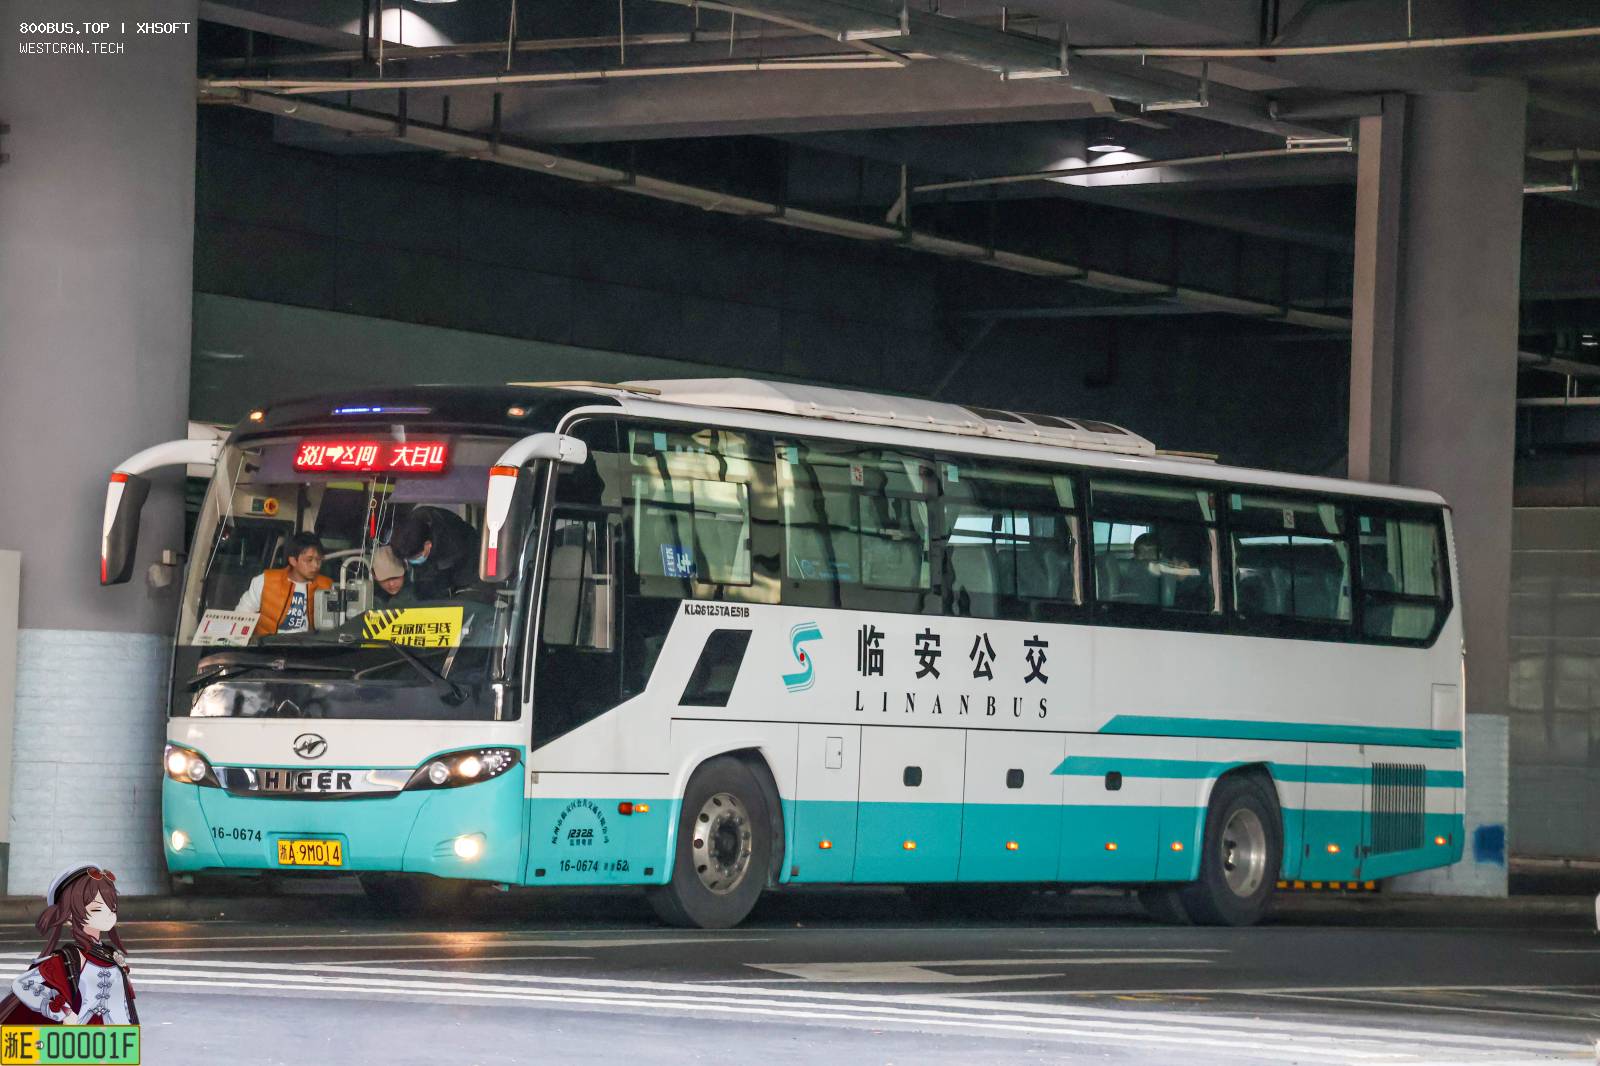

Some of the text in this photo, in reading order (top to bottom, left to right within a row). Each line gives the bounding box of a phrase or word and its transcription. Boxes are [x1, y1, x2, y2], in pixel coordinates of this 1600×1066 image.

[857, 624, 1049, 685] 临安公交
[855, 690, 1048, 719] LINANBUS
[265, 771, 352, 790] HIGER
[211, 826, 262, 842] 16-0674
[560, 859, 599, 873] 16-0674
